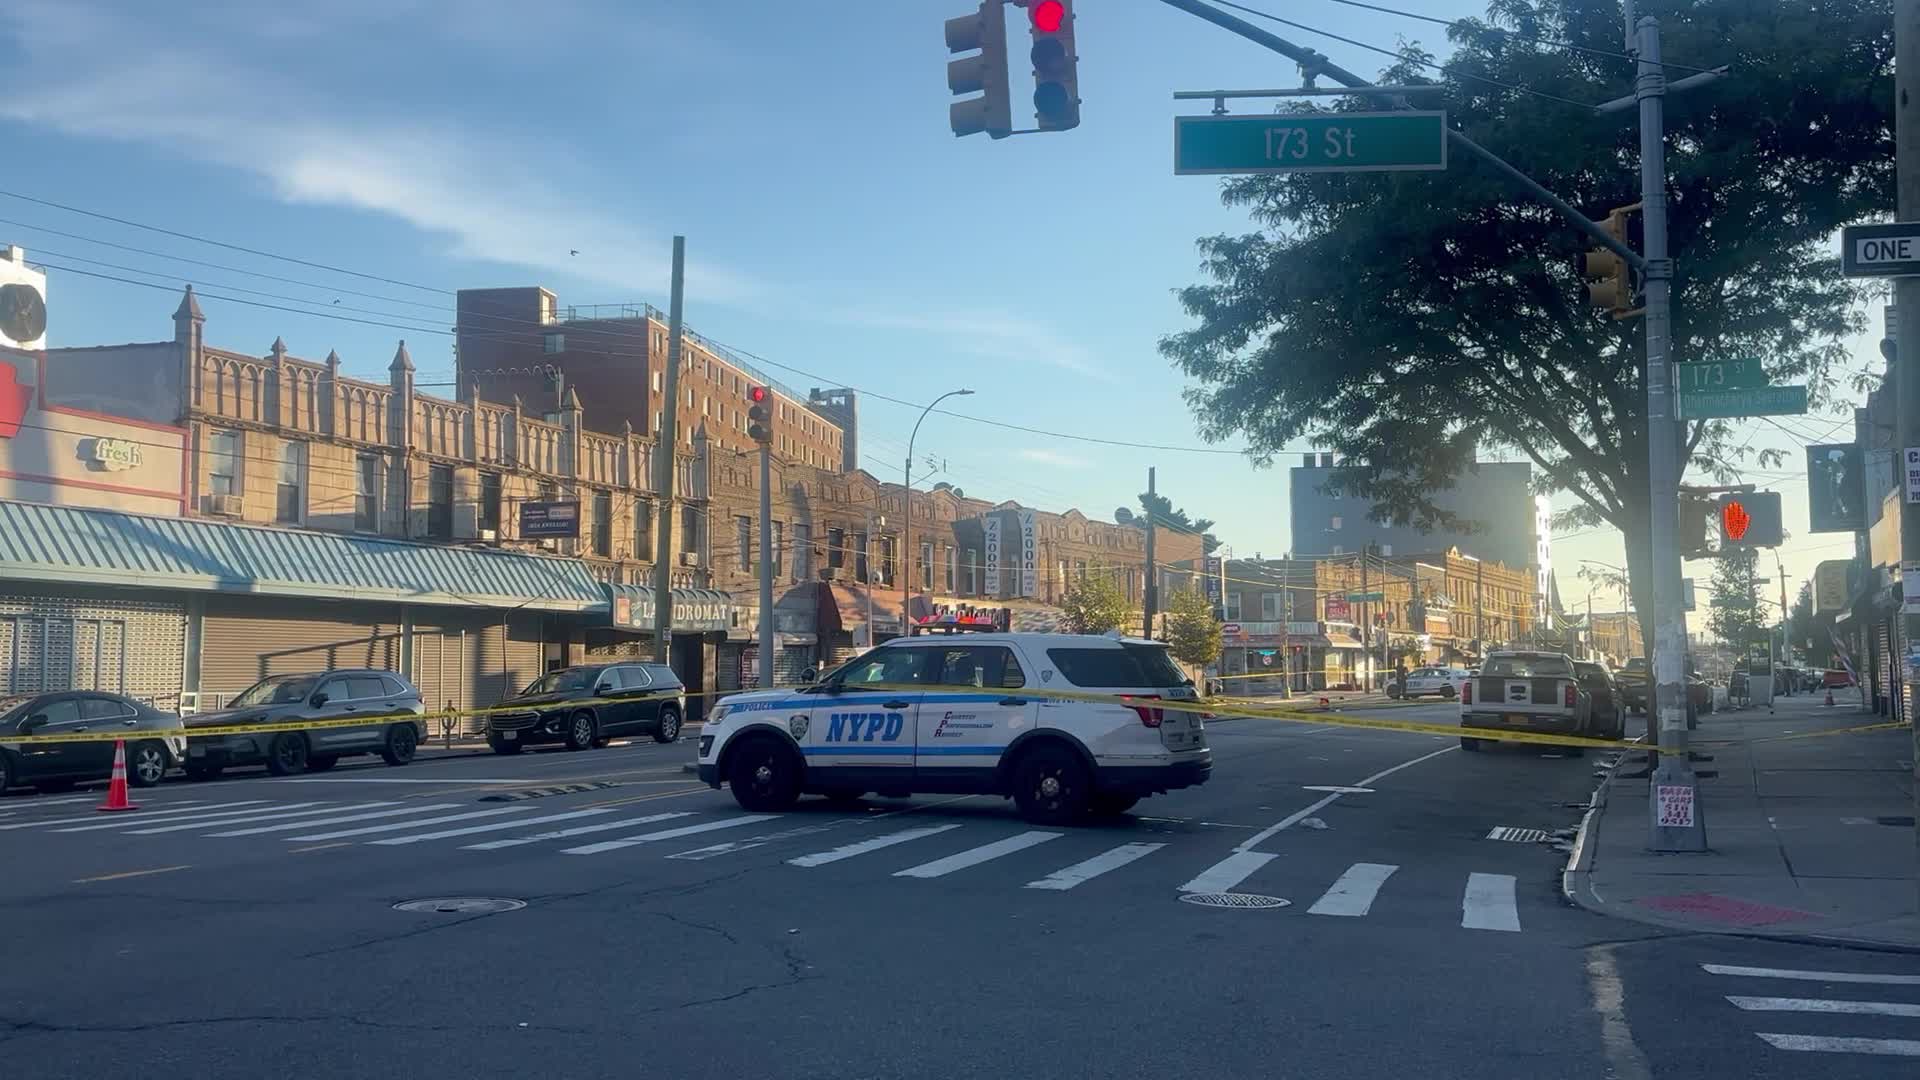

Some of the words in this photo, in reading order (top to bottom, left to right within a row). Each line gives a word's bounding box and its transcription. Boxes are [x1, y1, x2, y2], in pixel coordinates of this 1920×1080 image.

[1264, 127, 1309, 160] 173
[1325, 127, 1356, 159] St
[1864, 240, 1912, 260] ONE
[1692, 363, 1725, 386] 173
[98, 439, 141, 465] fresh
[825, 713, 903, 742] NYPD
